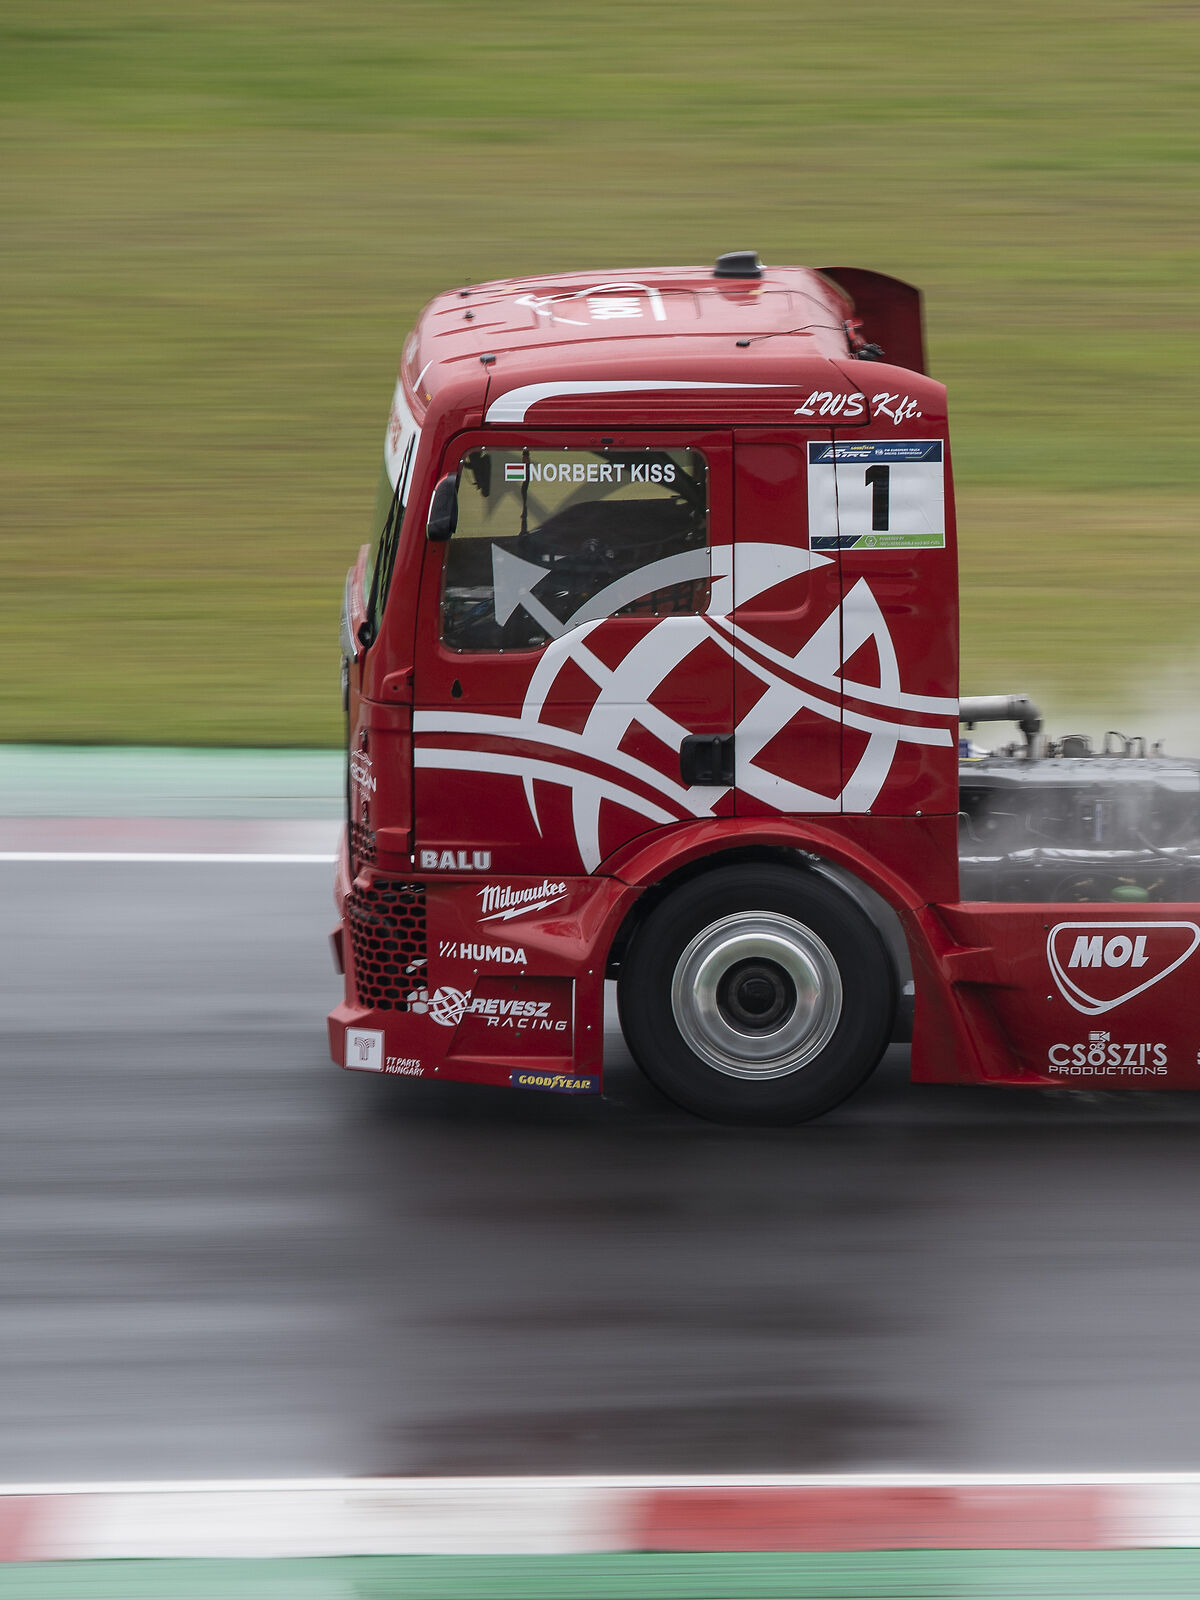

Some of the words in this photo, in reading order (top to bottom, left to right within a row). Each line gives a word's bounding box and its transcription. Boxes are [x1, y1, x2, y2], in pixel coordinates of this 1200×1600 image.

[794, 391, 866, 417] LWS
[869, 393, 922, 425] Kft.
[530, 463, 625, 482] NORBERT
[631, 464, 676, 482] KISS
[865, 465, 889, 531] 1
[421, 850, 491, 870] BALU
[476, 880, 568, 913] Milwaukee
[460, 943, 527, 965] HUMDA
[1068, 935, 1149, 968] MOL
[487, 1017, 567, 1031] RACING
[385, 1065, 425, 1076] HUNGARY
[386, 1057, 397, 1065] TT
[397, 1058, 420, 1068] PARTS
[1048, 1066, 1168, 1075] PRODUCTIONS
[519, 1075, 591, 1089] GOODYEAR
